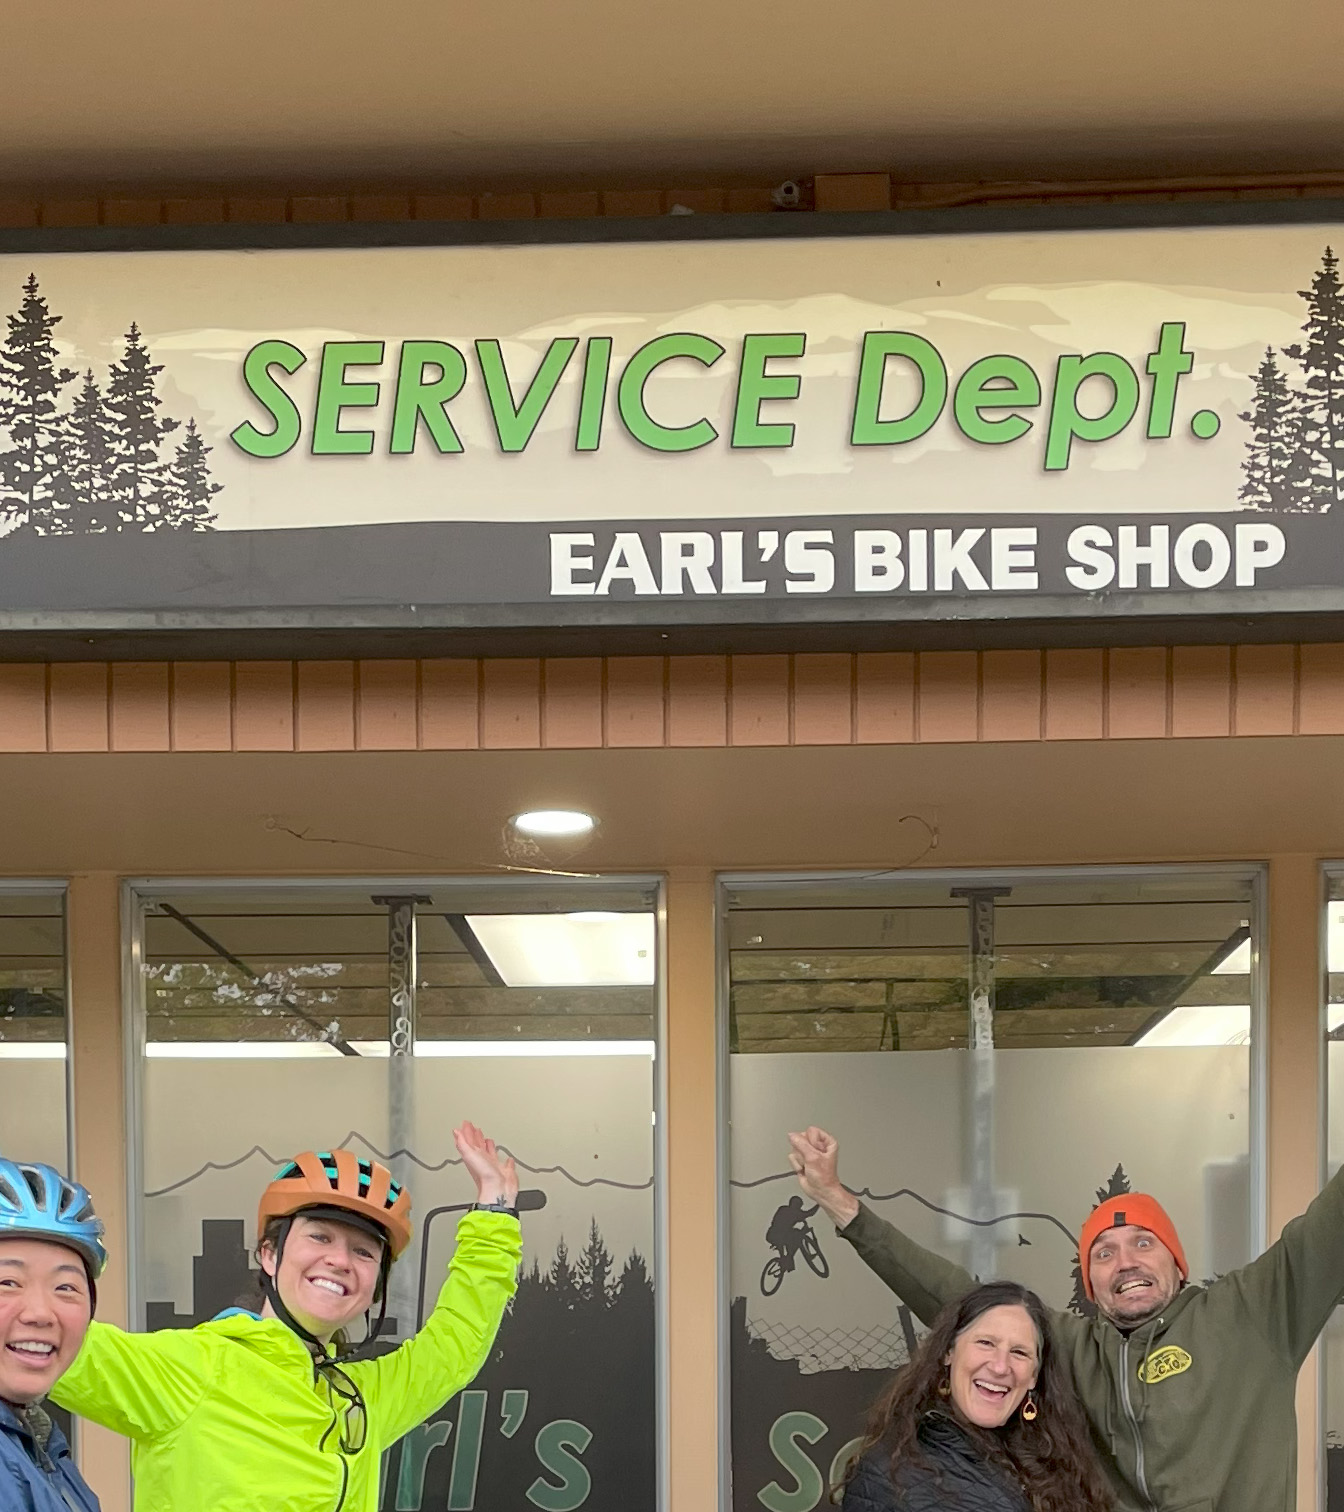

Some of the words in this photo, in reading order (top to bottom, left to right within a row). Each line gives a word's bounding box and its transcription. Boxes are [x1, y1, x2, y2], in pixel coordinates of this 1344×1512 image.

[231, 333, 806, 457] SERVICE
[850, 321, 1224, 470] Dept.
[549, 530, 836, 597] EARL'S
[854, 526, 1040, 592] BIKE
[1065, 522, 1287, 591] SHOP
